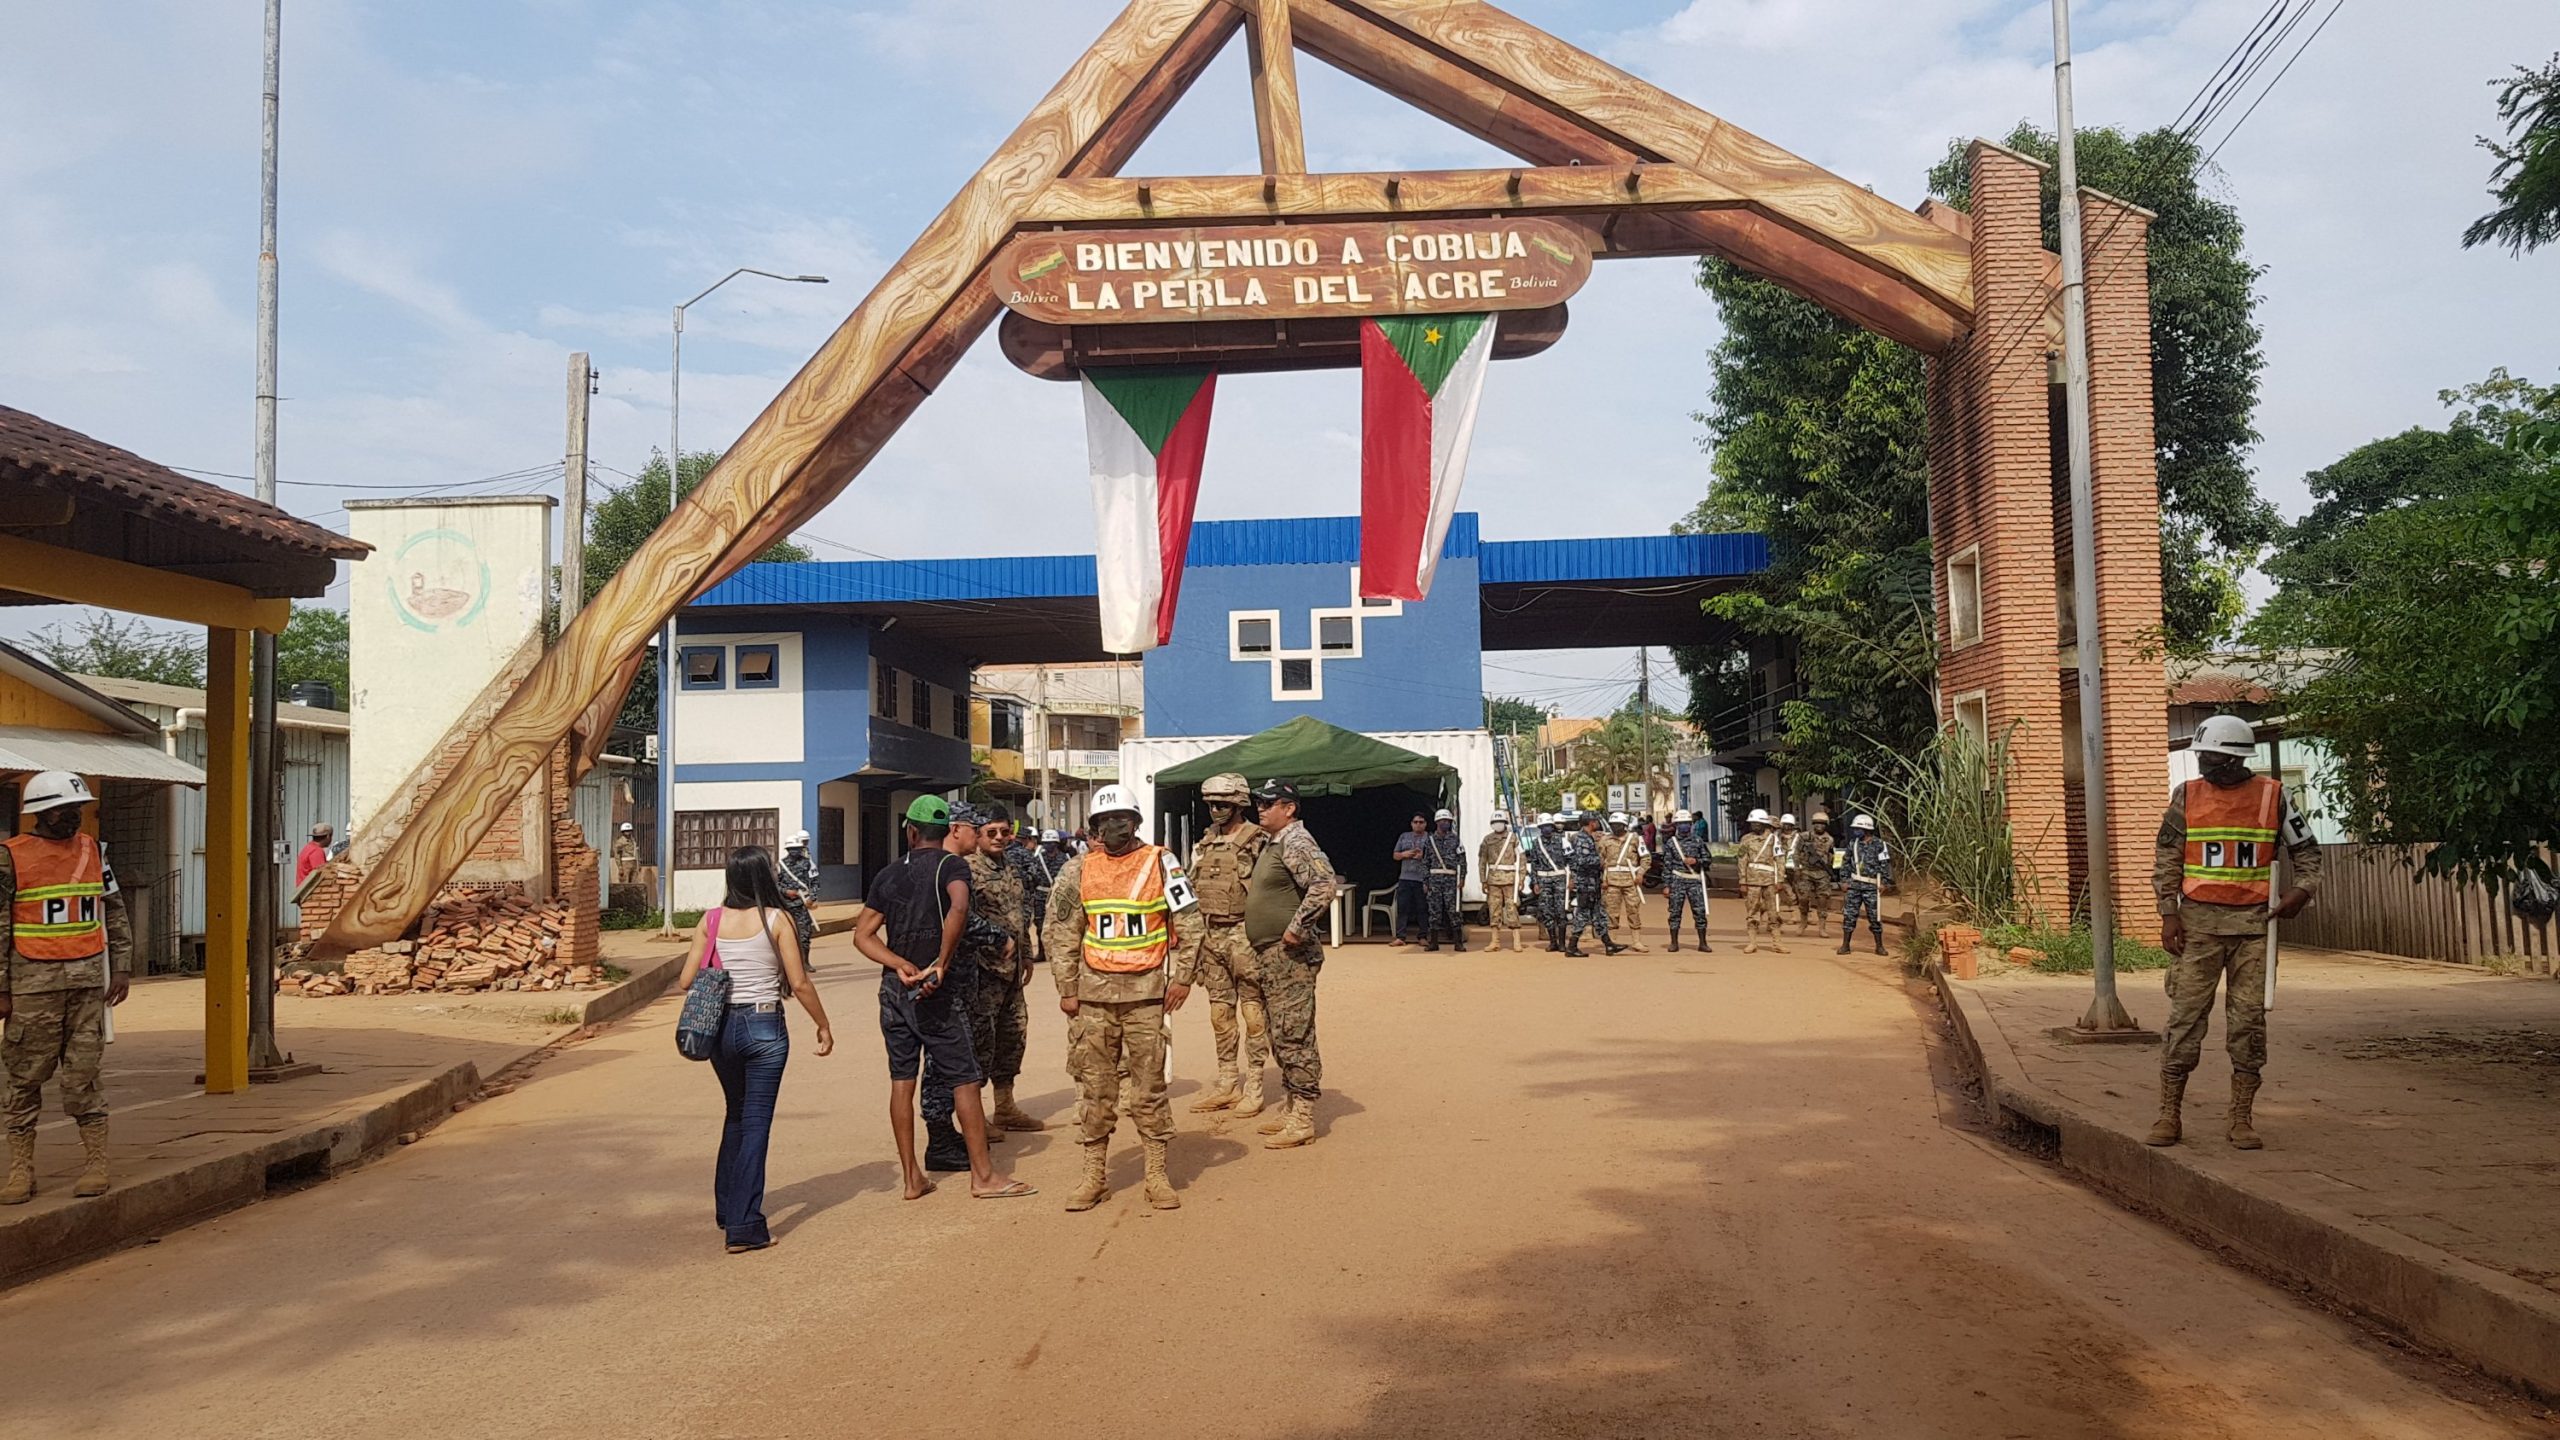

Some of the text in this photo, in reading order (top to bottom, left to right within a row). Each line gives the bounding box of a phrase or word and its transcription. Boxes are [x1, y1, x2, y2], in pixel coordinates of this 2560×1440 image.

[1076, 231, 1527, 271] BIENVENIDO A COBIJA
[1509, 276, 1558, 289] Bolivia
[1066, 269, 1506, 310] LA PERLA DEL ACRE
[1009, 291, 1059, 304] Bolivia
[1099, 793, 1117, 805] PM
[1611, 790, 1622, 799] 40
